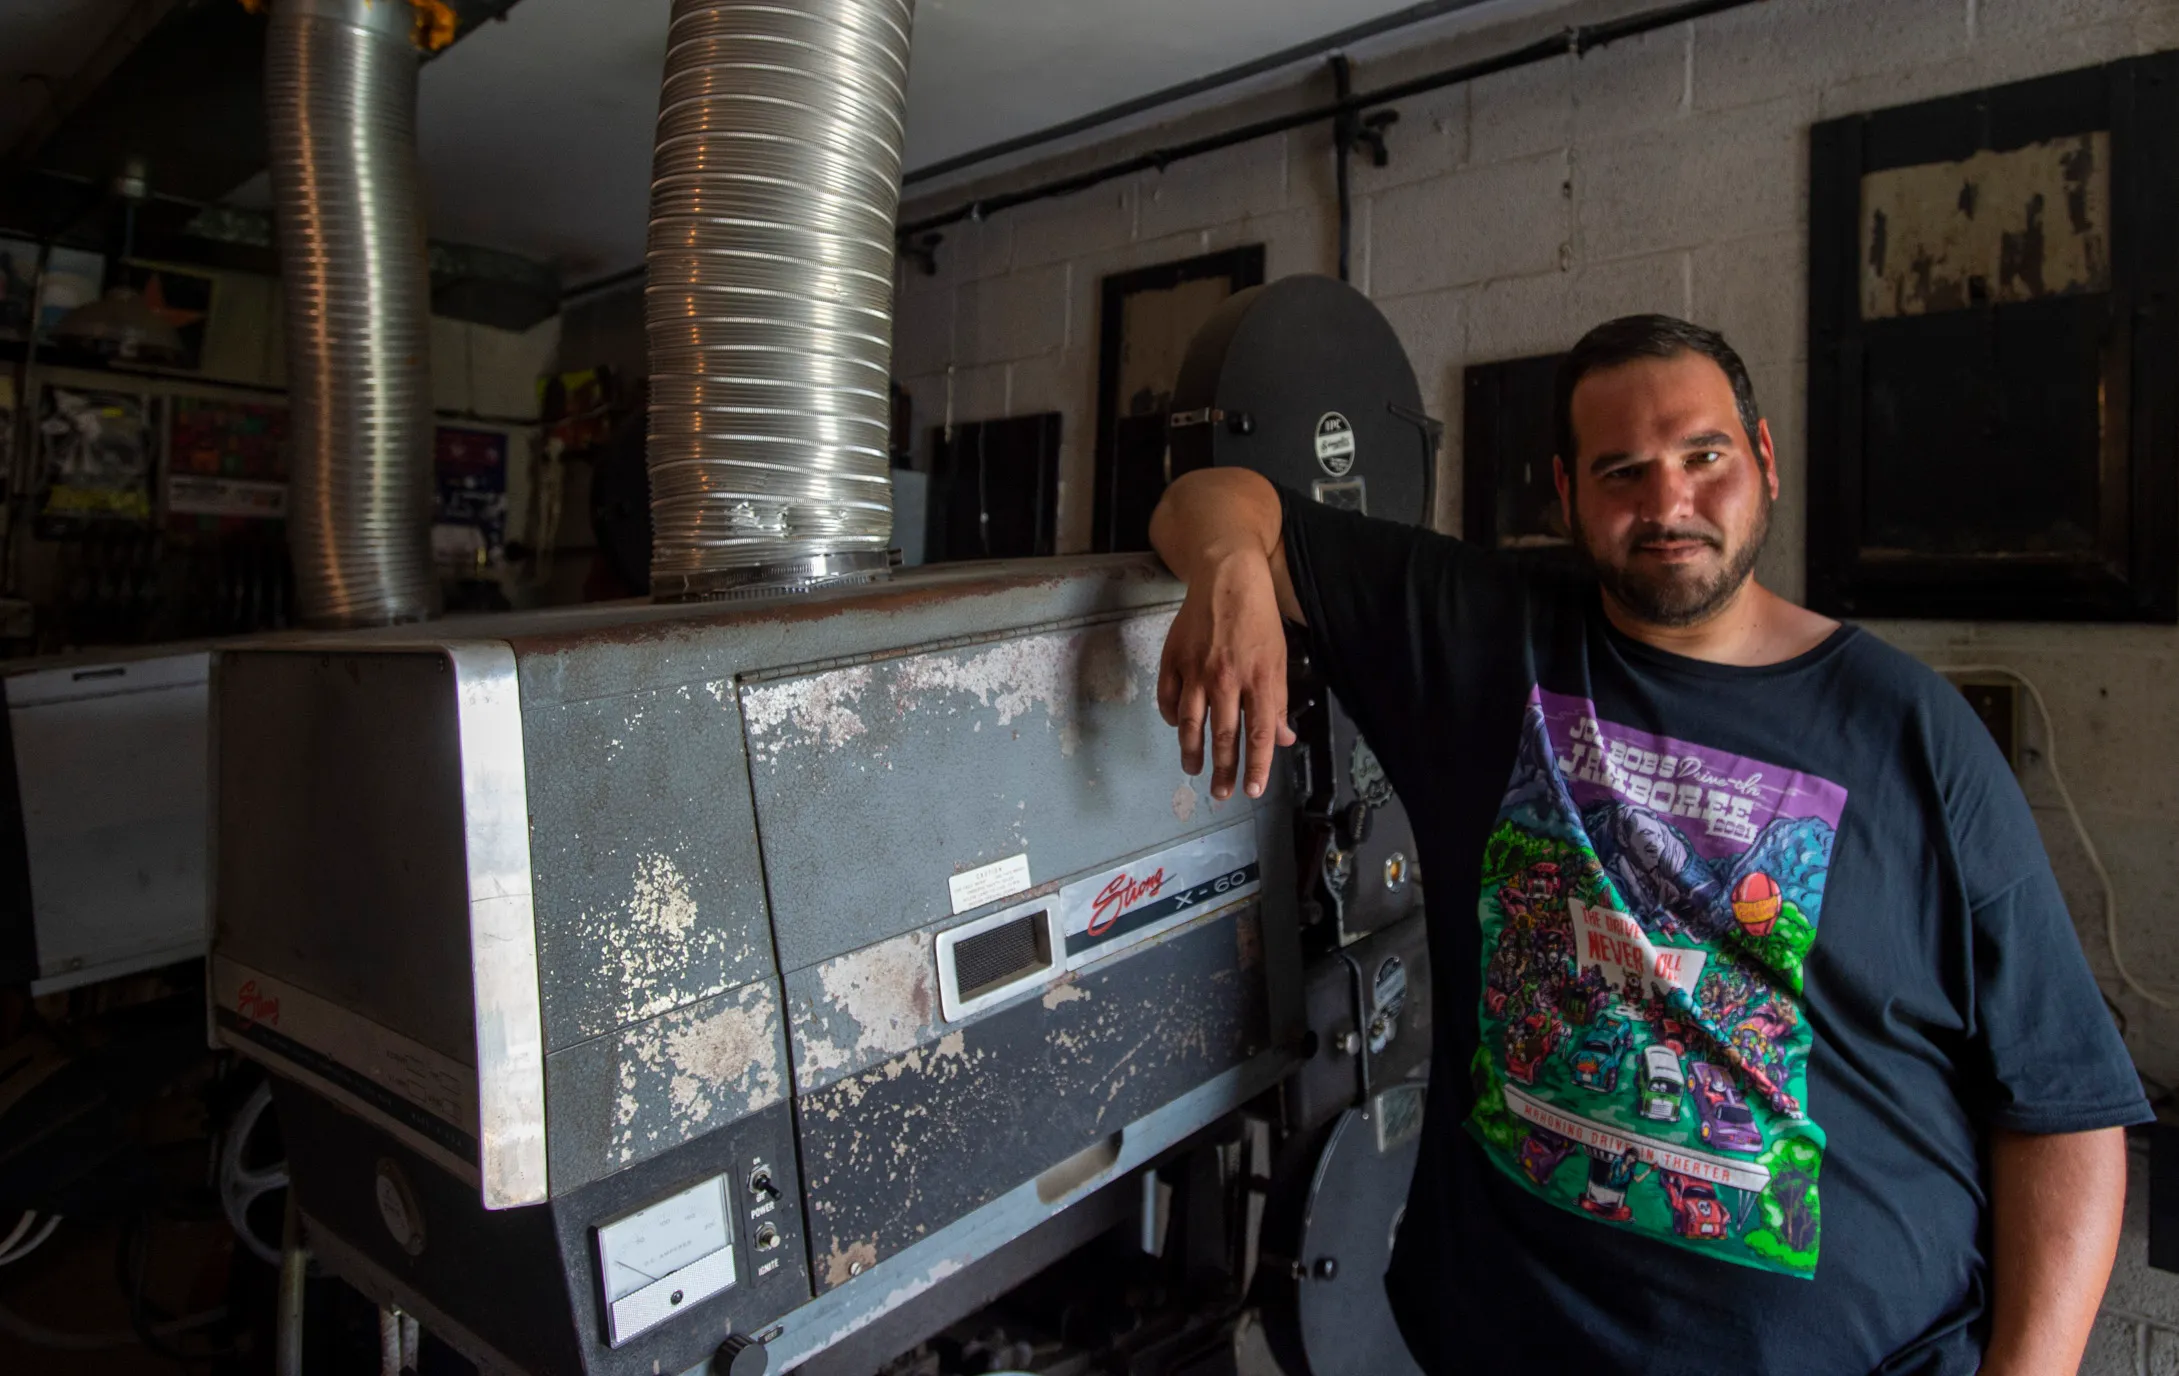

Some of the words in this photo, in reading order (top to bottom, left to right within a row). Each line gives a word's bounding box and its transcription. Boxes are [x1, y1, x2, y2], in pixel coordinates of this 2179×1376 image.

[1558, 743, 1754, 823] JAMBOREE
[1088, 866, 1165, 937] Strong
[1581, 905, 1602, 929] THE
[1605, 915, 1640, 939] DRIVE
[1588, 930, 1644, 976] NEVER
[1524, 1104, 1583, 1140] MAHONING
[1591, 1132, 1632, 1151] DRIVE
[1640, 1147, 1654, 1161] IN
[1664, 1153, 1731, 1182] THEATER
[750, 1201, 775, 1220] POWER
[758, 1257, 779, 1277] IGNITE
